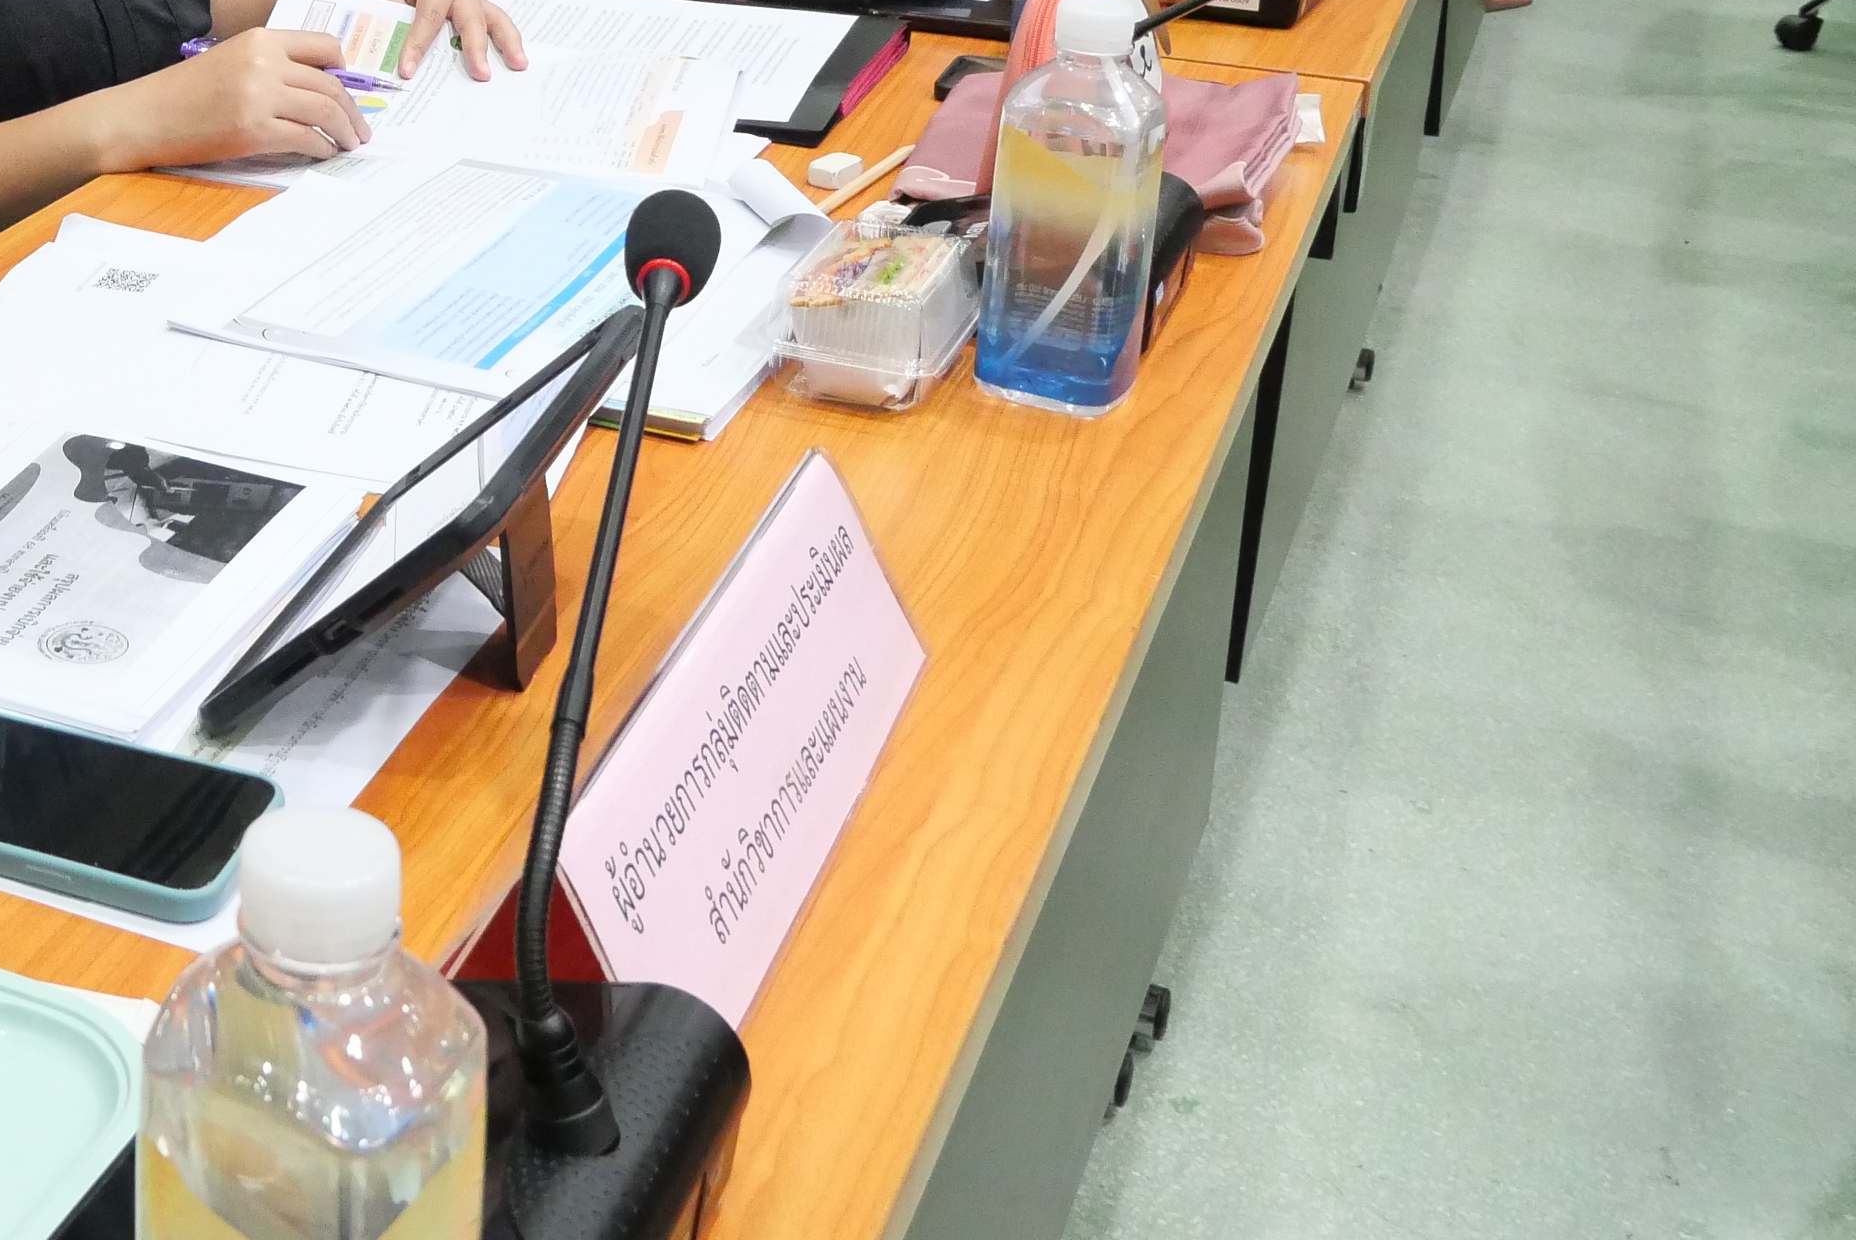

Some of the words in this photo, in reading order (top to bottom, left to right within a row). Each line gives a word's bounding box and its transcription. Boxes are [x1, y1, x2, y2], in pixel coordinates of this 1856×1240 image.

[604, 523, 856, 933] ผู้อำนวยการกลุ่มติดตามและประเมินผล
[707, 656, 868, 945] สำนักวิชาการและแผนงาน
